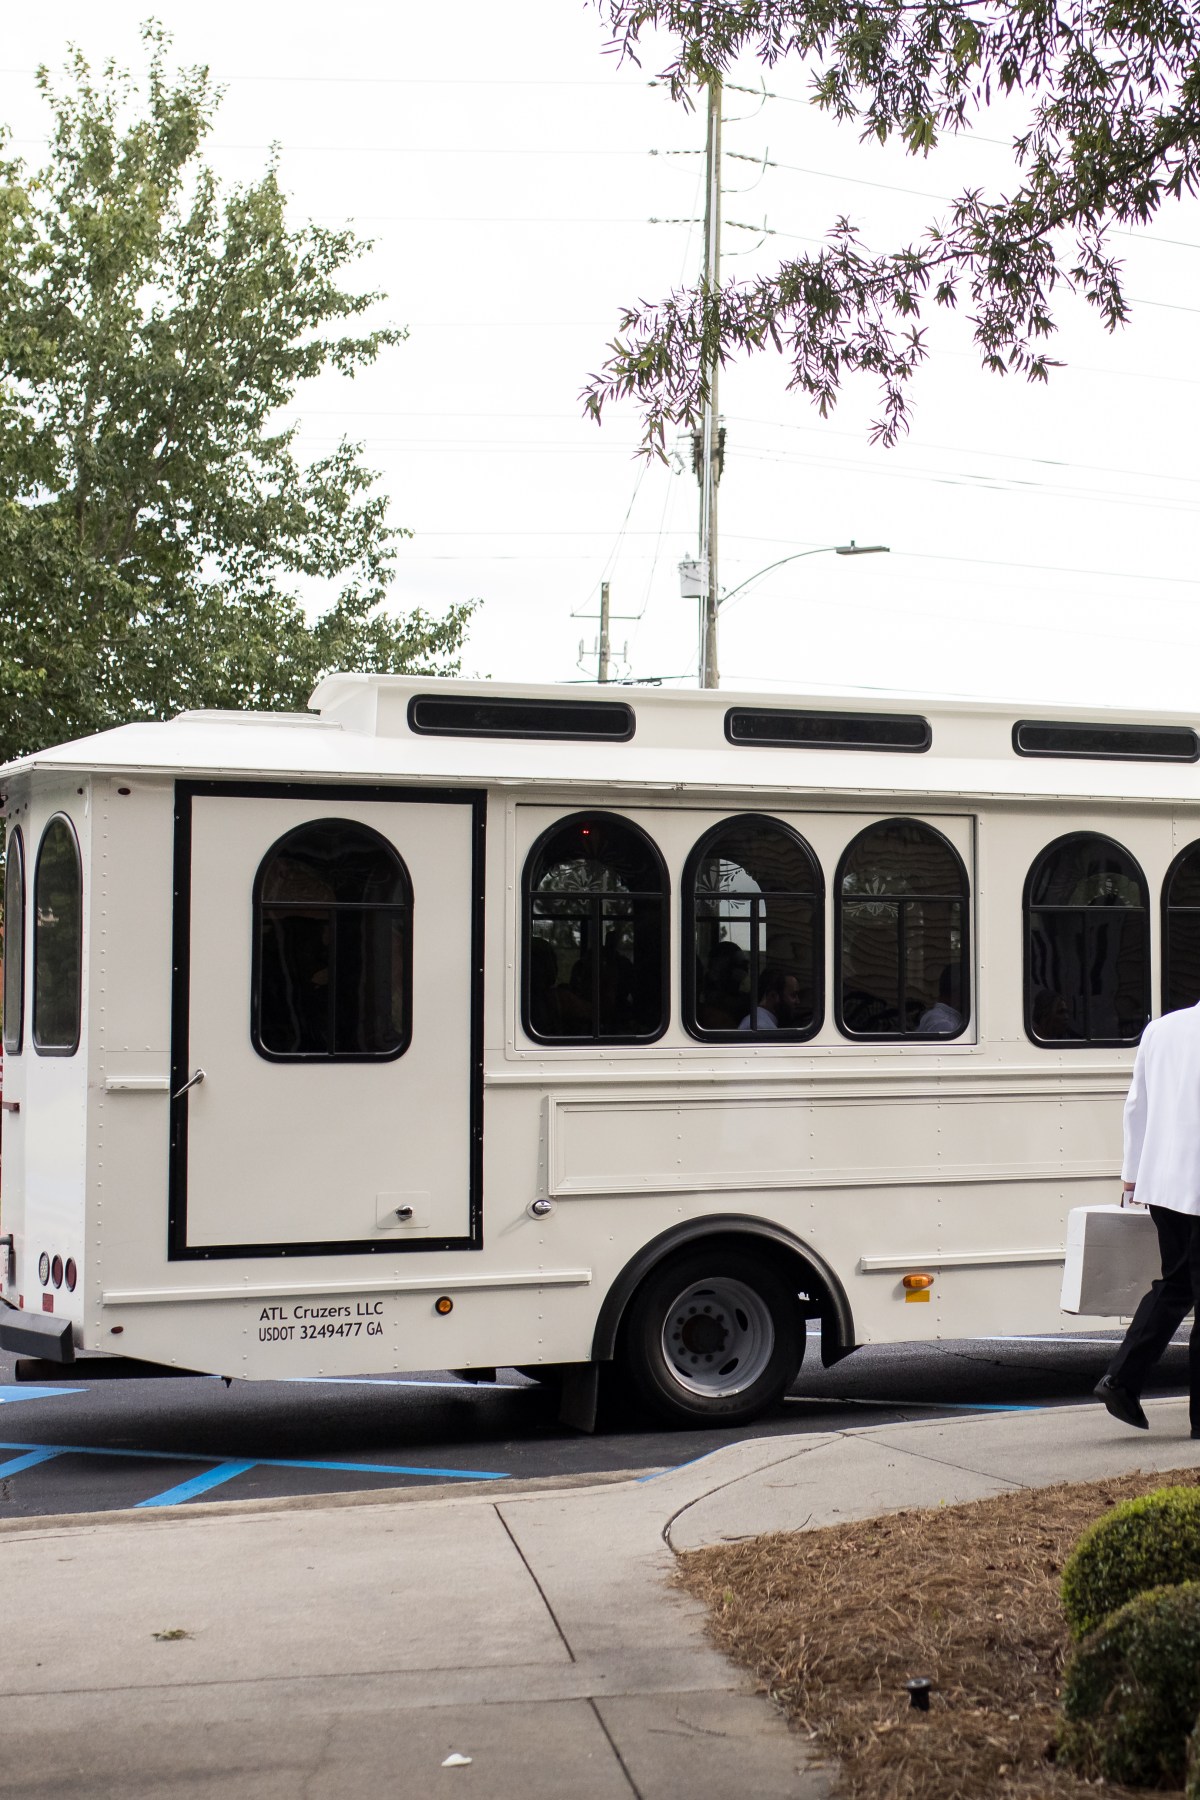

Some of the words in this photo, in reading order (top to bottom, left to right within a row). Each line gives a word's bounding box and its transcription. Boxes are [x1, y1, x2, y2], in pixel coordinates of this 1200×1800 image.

[259, 1307, 288, 1321] ATL
[293, 1305, 351, 1319] Cruzers
[356, 1301, 383, 1316] LLC
[258, 1326, 295, 1342] USDOT
[300, 1322, 363, 1339] 3249477
[366, 1321, 383, 1336] GA
